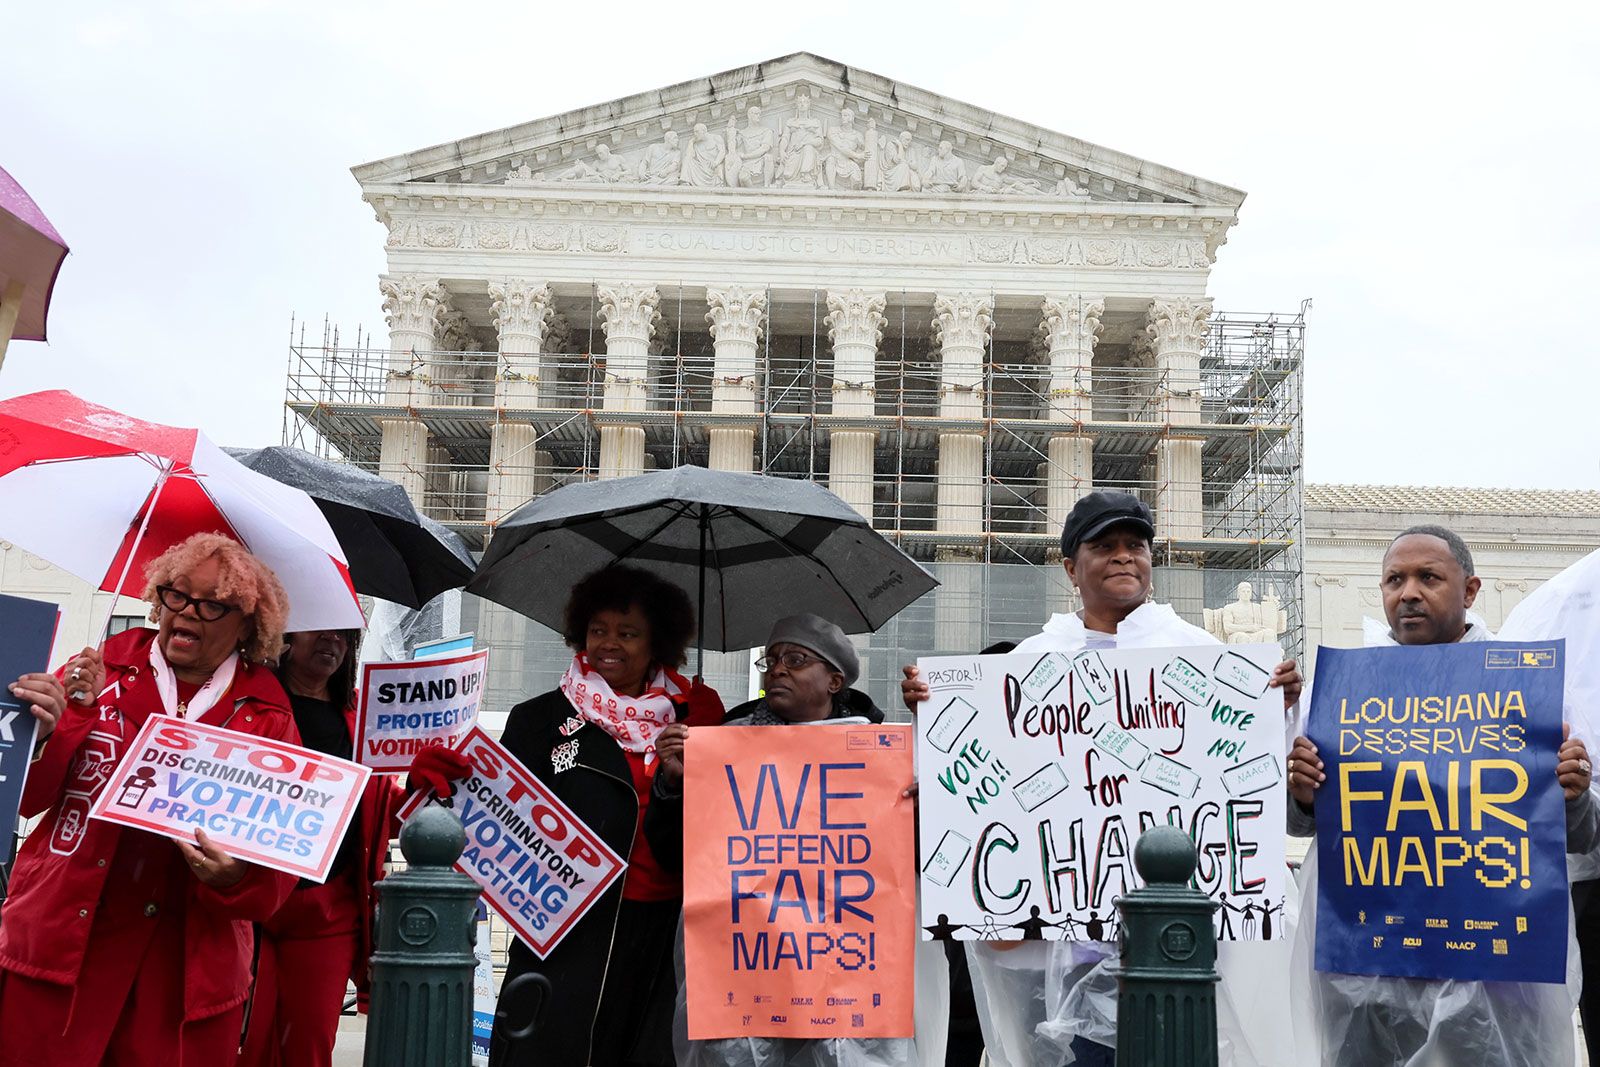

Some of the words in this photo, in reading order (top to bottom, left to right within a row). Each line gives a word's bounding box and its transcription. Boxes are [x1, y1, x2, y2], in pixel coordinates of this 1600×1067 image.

[645, 232, 720, 250] EQUAL
[725, 235, 814, 253] JUSTICE
[825, 239, 899, 255] UNDER
[909, 241, 952, 256] LAW
[377, 678, 457, 704] STAND
[462, 671, 482, 696] UP!
[928, 663, 983, 684] PASTOR!!
[376, 708, 460, 730] PROTECT
[1004, 670, 1093, 756] People
[1114, 668, 1186, 755] Uniting
[1211, 699, 1256, 731] VOTE
[1339, 690, 1528, 725] LOUISIANA
[154, 727, 344, 785] STOP
[937, 738, 991, 796] VOTE
[1207, 738, 1247, 763] NO!
[1339, 724, 1527, 756] DESERVES
[141, 748, 335, 810] DISCRIMINATORY
[724, 763, 867, 831] WE
[966, 757, 1012, 815] NO!!
[1084, 748, 1129, 807] for
[1238, 762, 1270, 784] NAACP
[1338, 759, 1530, 832] FAIR
[147, 797, 313, 858] PRACTICES
[168, 772, 325, 837] VOTING
[466, 745, 602, 868] STOP
[460, 797, 569, 914] VOTING
[461, 777, 585, 890] SCRIMINATORY
[727, 834, 872, 865] DEFEND
[463, 835, 550, 931] ACTICES
[1342, 836, 1532, 890] MAPS!
[731, 869, 876, 924] FAIR
[733, 932, 876, 971] MAPS!
[1403, 937, 1422, 947] ACLU
[1446, 941, 1477, 951] NAACP
[810, 1017, 836, 1026] NAACP
